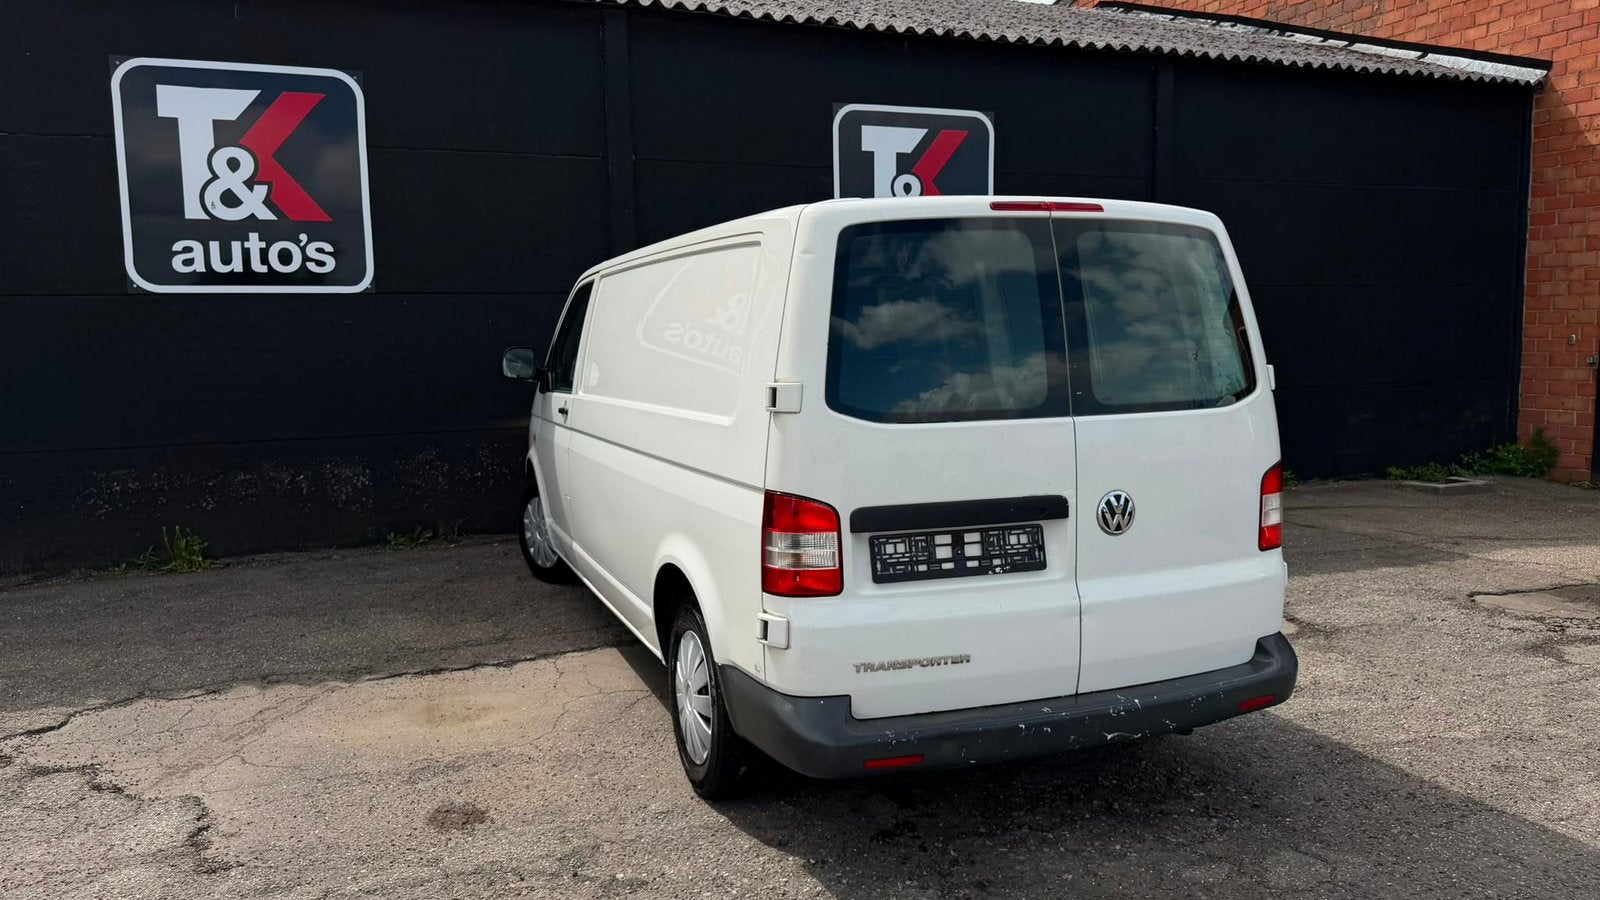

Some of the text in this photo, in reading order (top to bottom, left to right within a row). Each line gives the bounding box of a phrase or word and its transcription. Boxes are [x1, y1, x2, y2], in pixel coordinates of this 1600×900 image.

[156, 84, 333, 222] T&K
[171, 232, 336, 274] auto's
[1098, 491, 1134, 534] VW
[853, 654, 971, 673] TRANSPORTER
